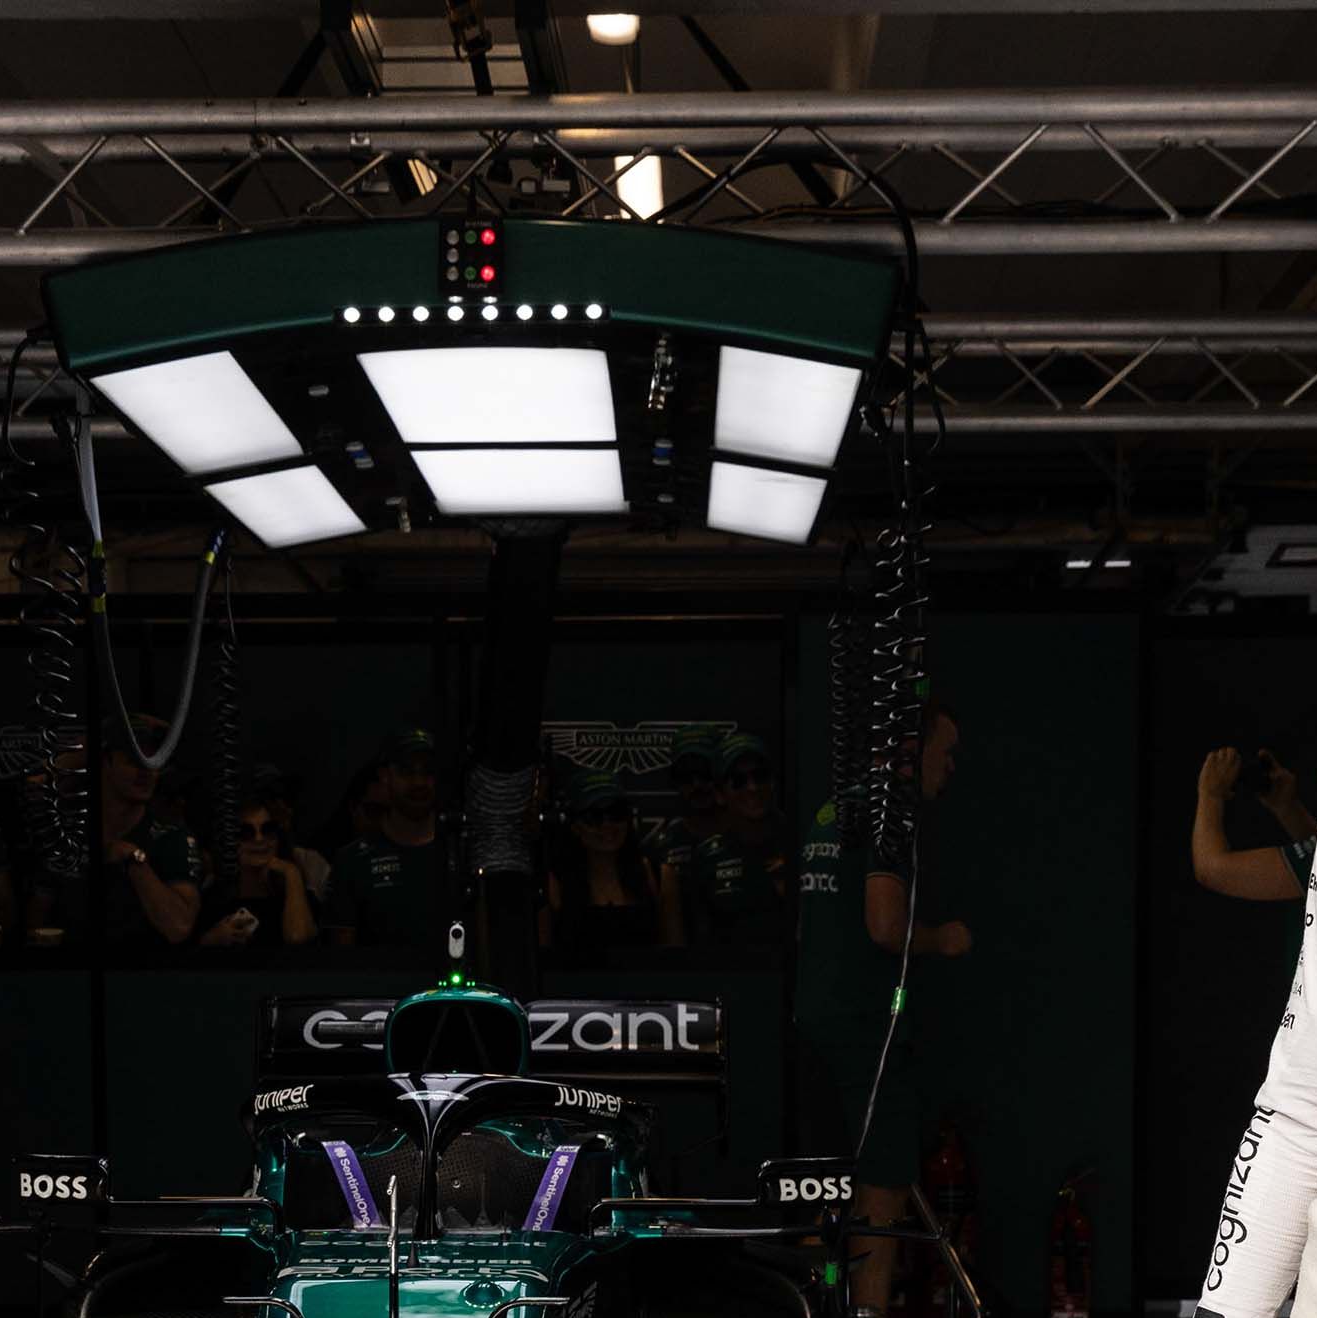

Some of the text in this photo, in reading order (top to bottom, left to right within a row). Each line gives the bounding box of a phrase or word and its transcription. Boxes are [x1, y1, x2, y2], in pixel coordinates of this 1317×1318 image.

[19, 1172, 87, 1199] BOSS
[340, 1157, 372, 1226] SentinelOne
[779, 1175, 851, 1201] BOSS
